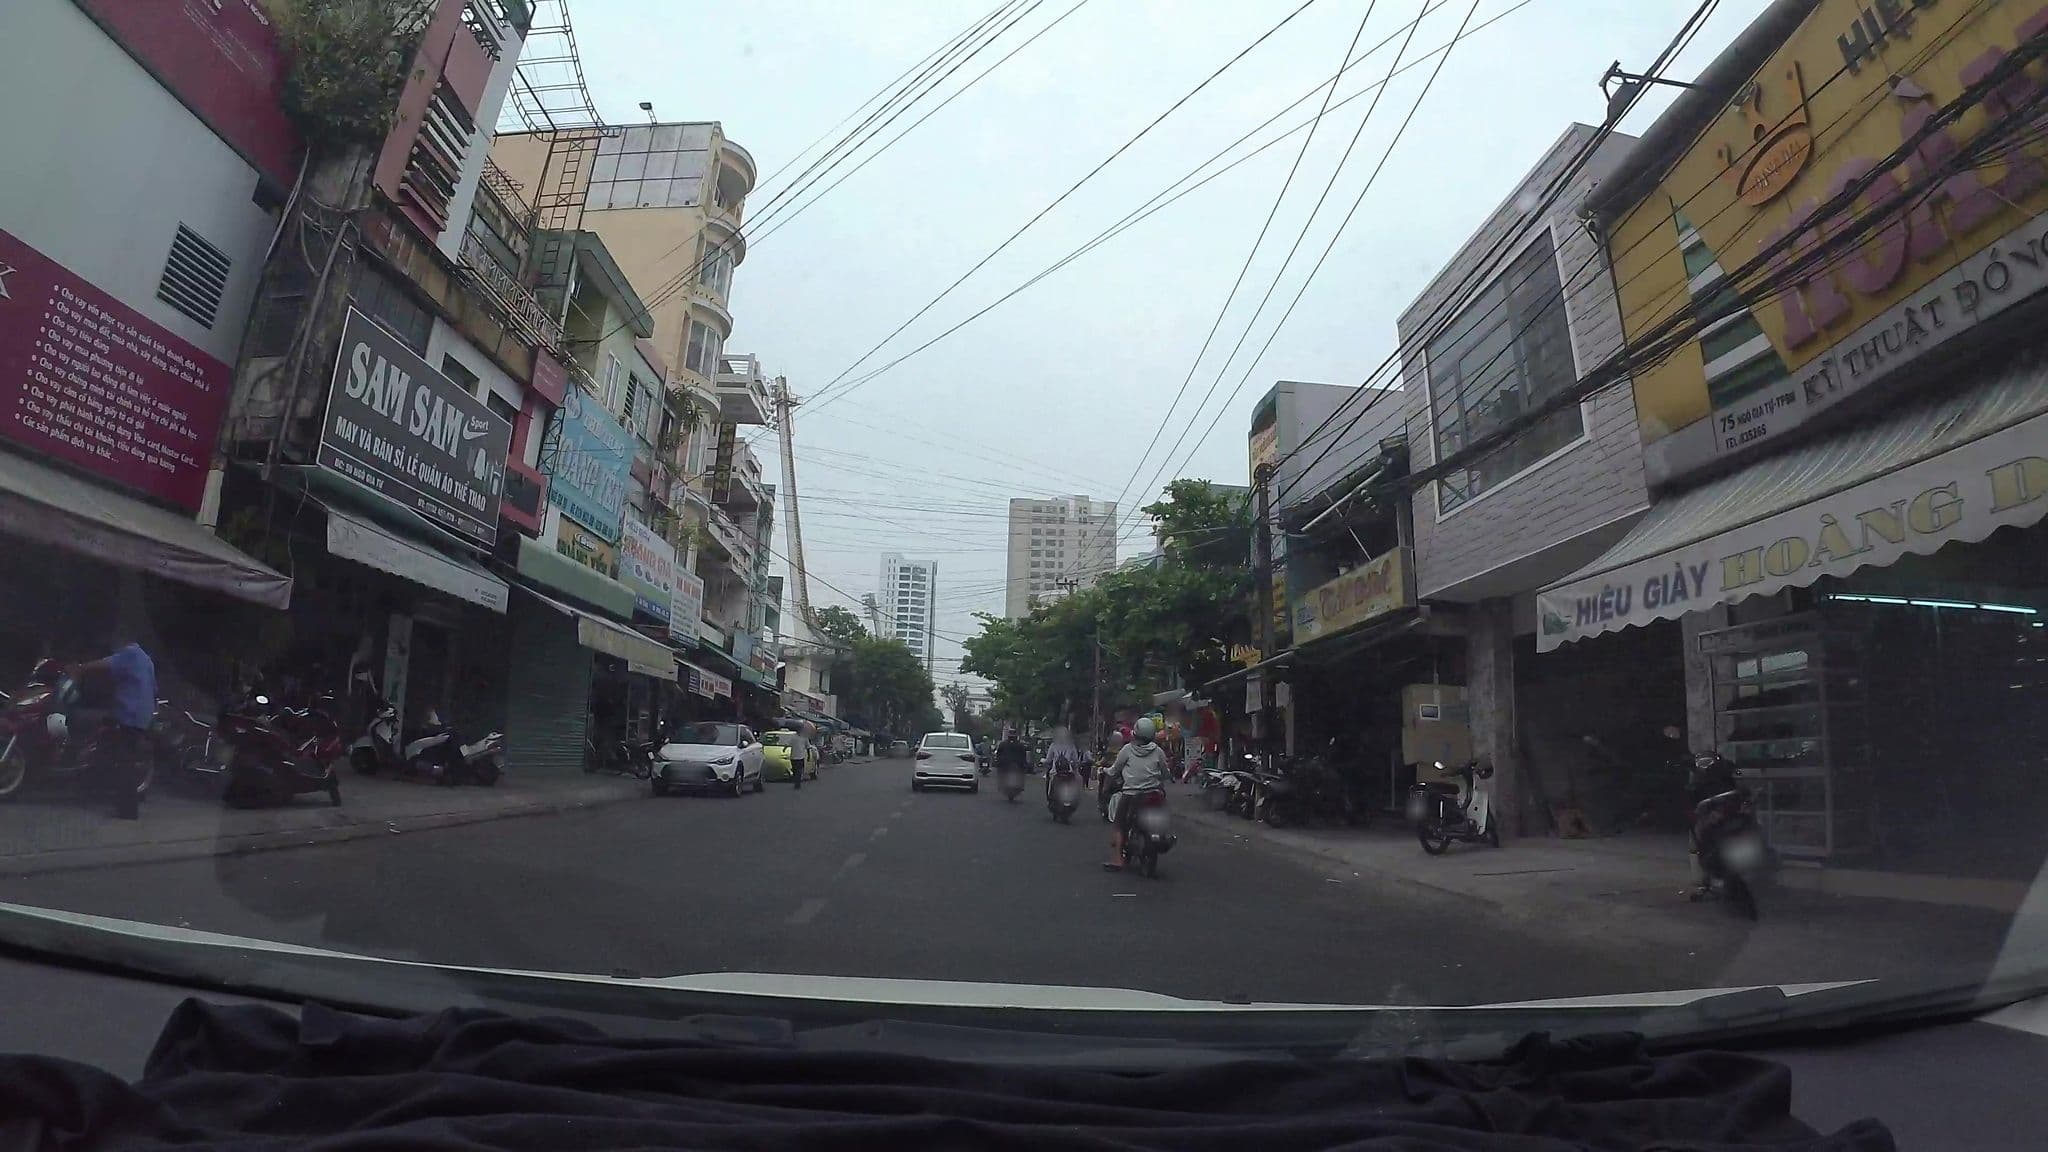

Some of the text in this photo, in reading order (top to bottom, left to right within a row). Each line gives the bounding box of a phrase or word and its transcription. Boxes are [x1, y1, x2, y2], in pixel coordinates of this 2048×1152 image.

[1843, 296, 1944, 377] THUẬT
[345, 342, 489, 458] SAM SAM Sport
[1720, 414, 1736, 433] 75
[1752, 405, 1764, 419] GIA
[335, 415, 359, 444] MAY
[359, 427, 372, 453] VÀ
[373, 435, 393, 464] BÁN
[407, 458, 417, 477] LẺ
[418, 463, 441, 491] QUẦN
[441, 471, 453, 494] ÁO
[453, 481, 470, 502] THỂ
[468, 490, 486, 512] THAO
[1575, 578, 1633, 630] HIỆU
[1643, 560, 1710, 611] GIÀY
[1719, 481, 1965, 592] HOÀNG
